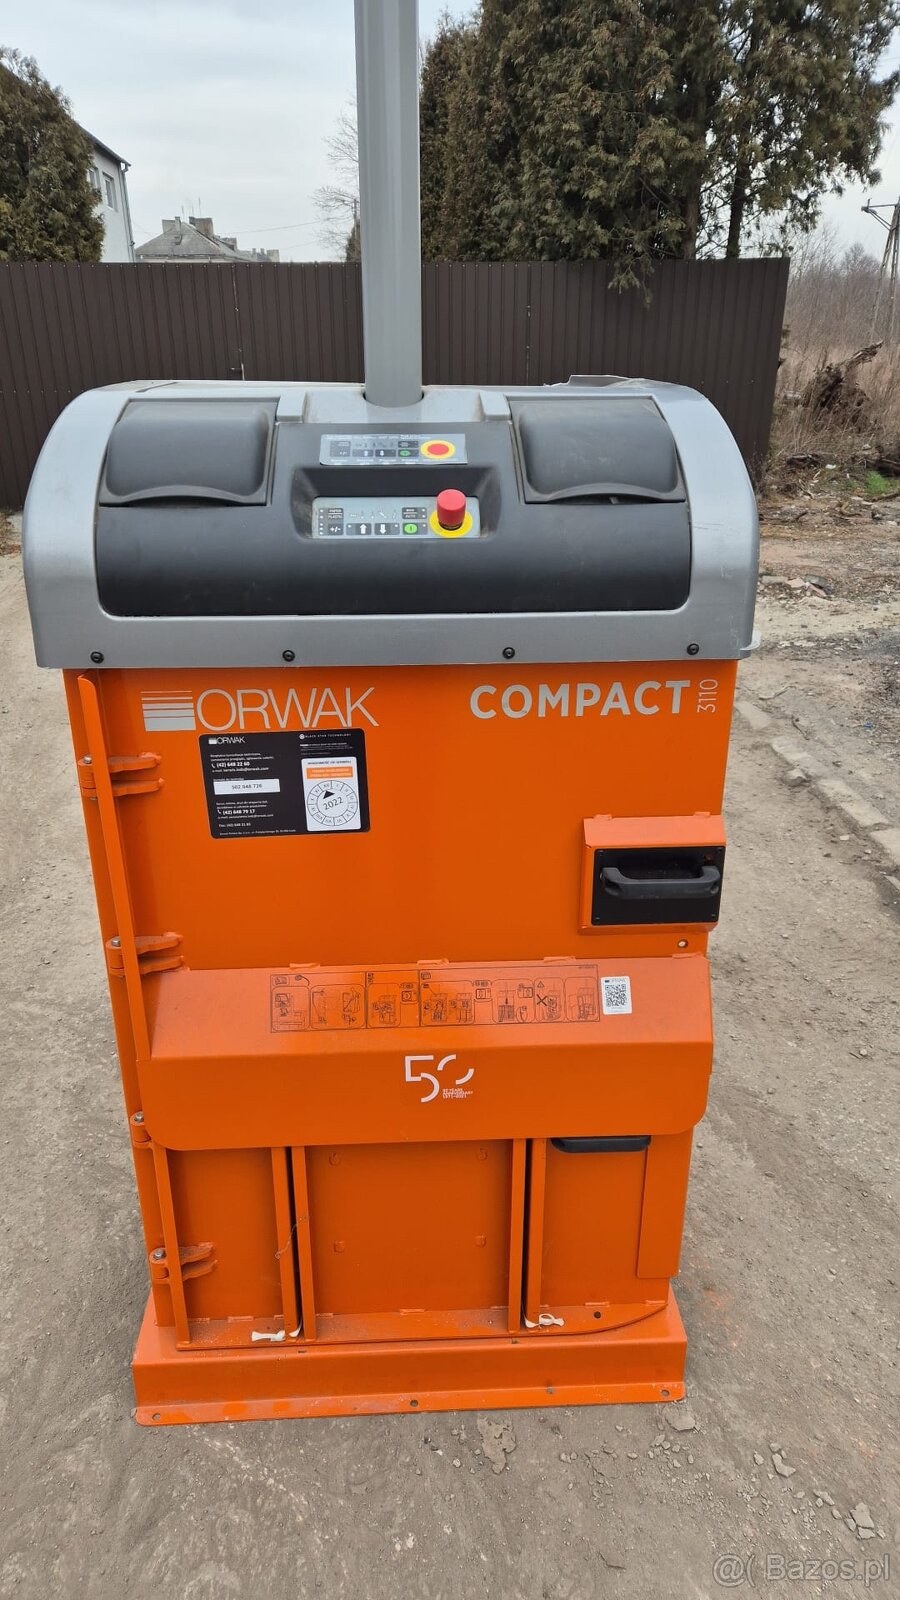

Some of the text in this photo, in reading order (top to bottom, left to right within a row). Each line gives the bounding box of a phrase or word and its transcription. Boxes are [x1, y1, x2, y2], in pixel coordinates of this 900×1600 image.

[196, 686, 380, 731] ORWAK
[470, 679, 691, 719] COMPACT
[696, 678, 719, 713] 3110
[216, 736, 246, 745] ORWAK
[322, 796, 344, 811] 2022
